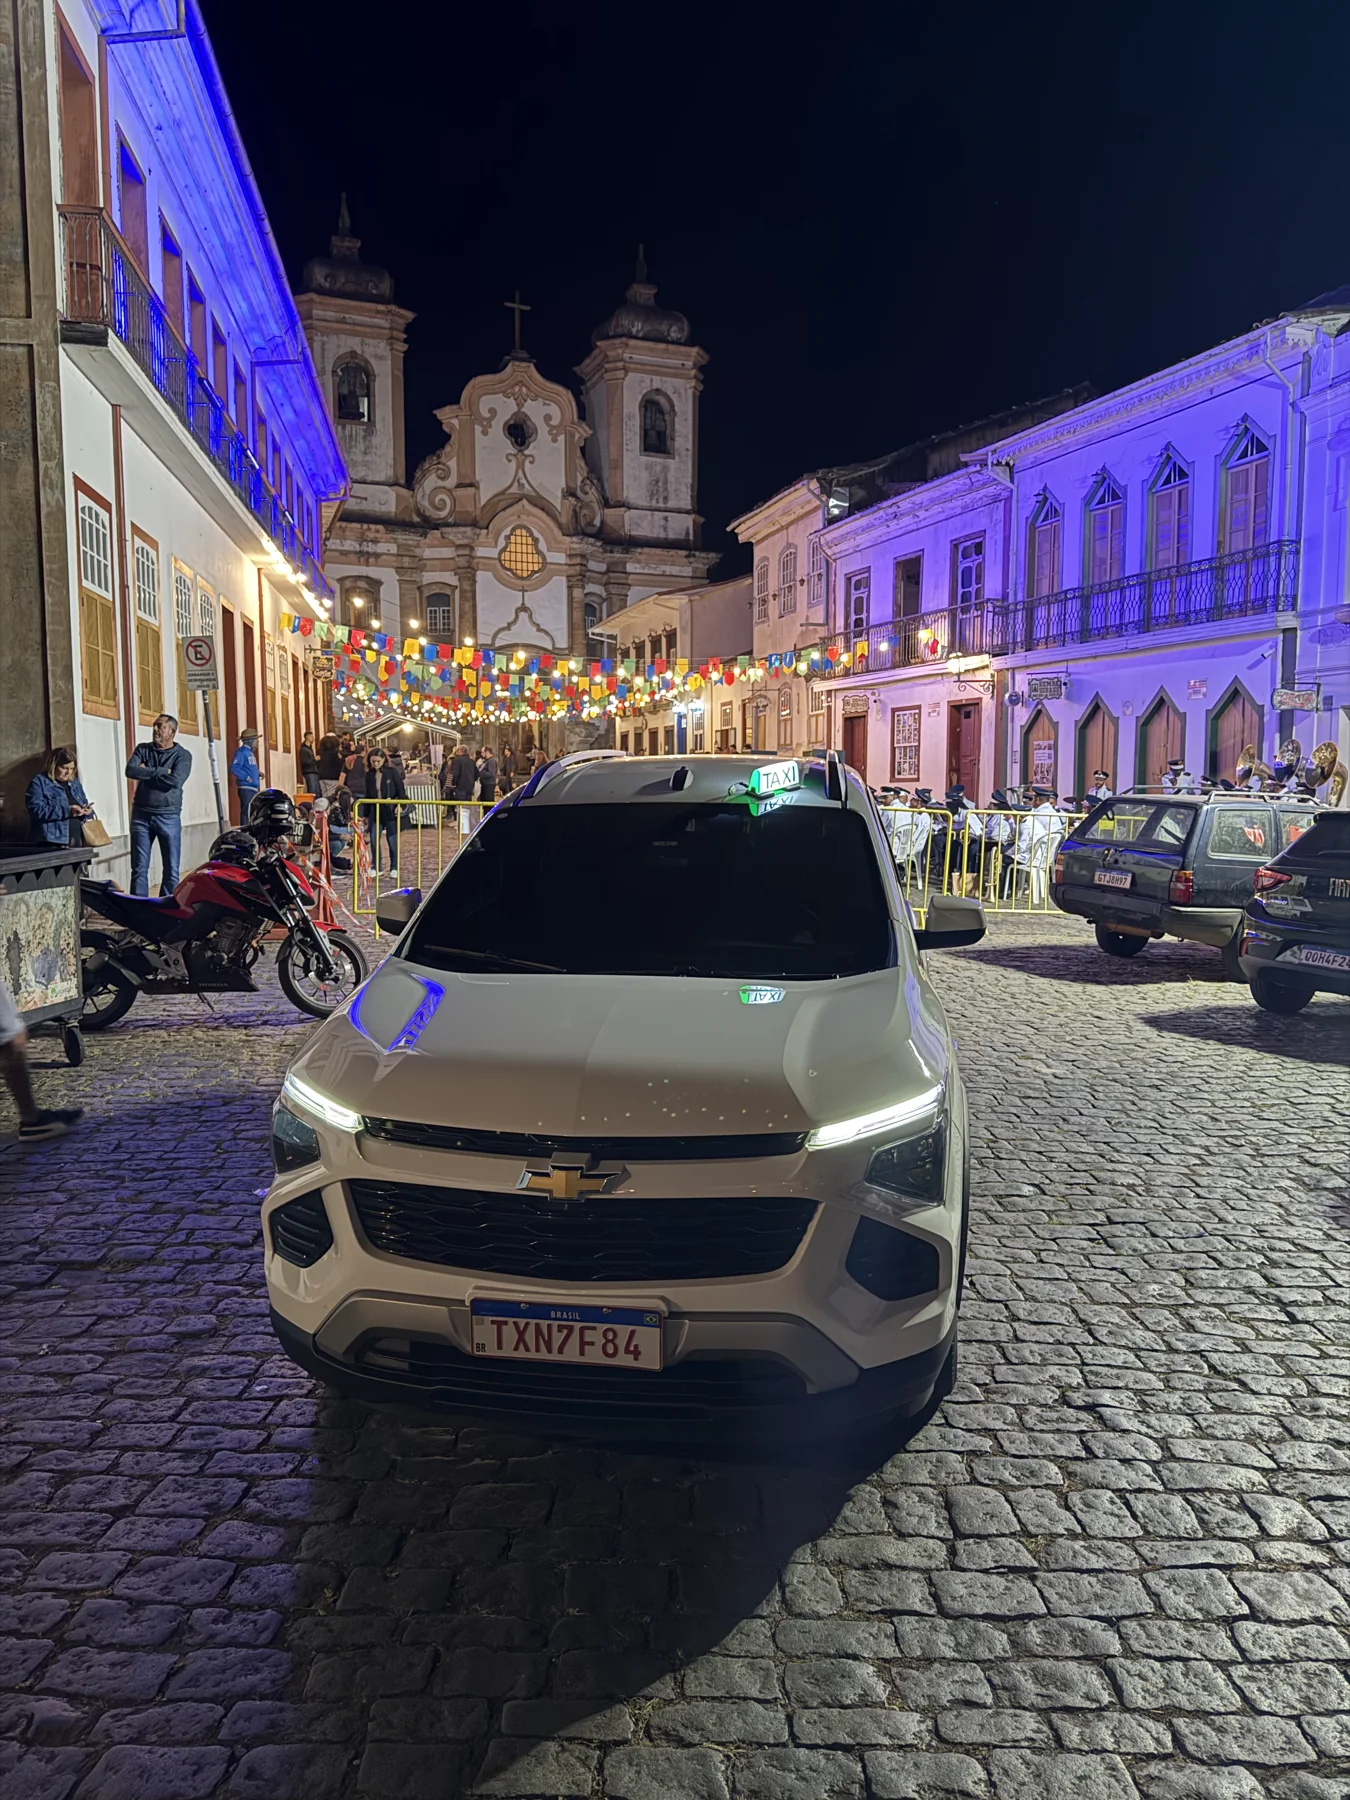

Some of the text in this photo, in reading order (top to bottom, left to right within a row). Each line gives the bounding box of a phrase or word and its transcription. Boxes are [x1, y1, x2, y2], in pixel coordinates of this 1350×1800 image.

[762, 765, 796, 789] TAXI
[1097, 873, 1128, 887] GTJ8H97
[550, 1310, 581, 1320] BRASIL
[489, 1319, 642, 1362] TXN7F84
[475, 1342, 486, 1354] BR
